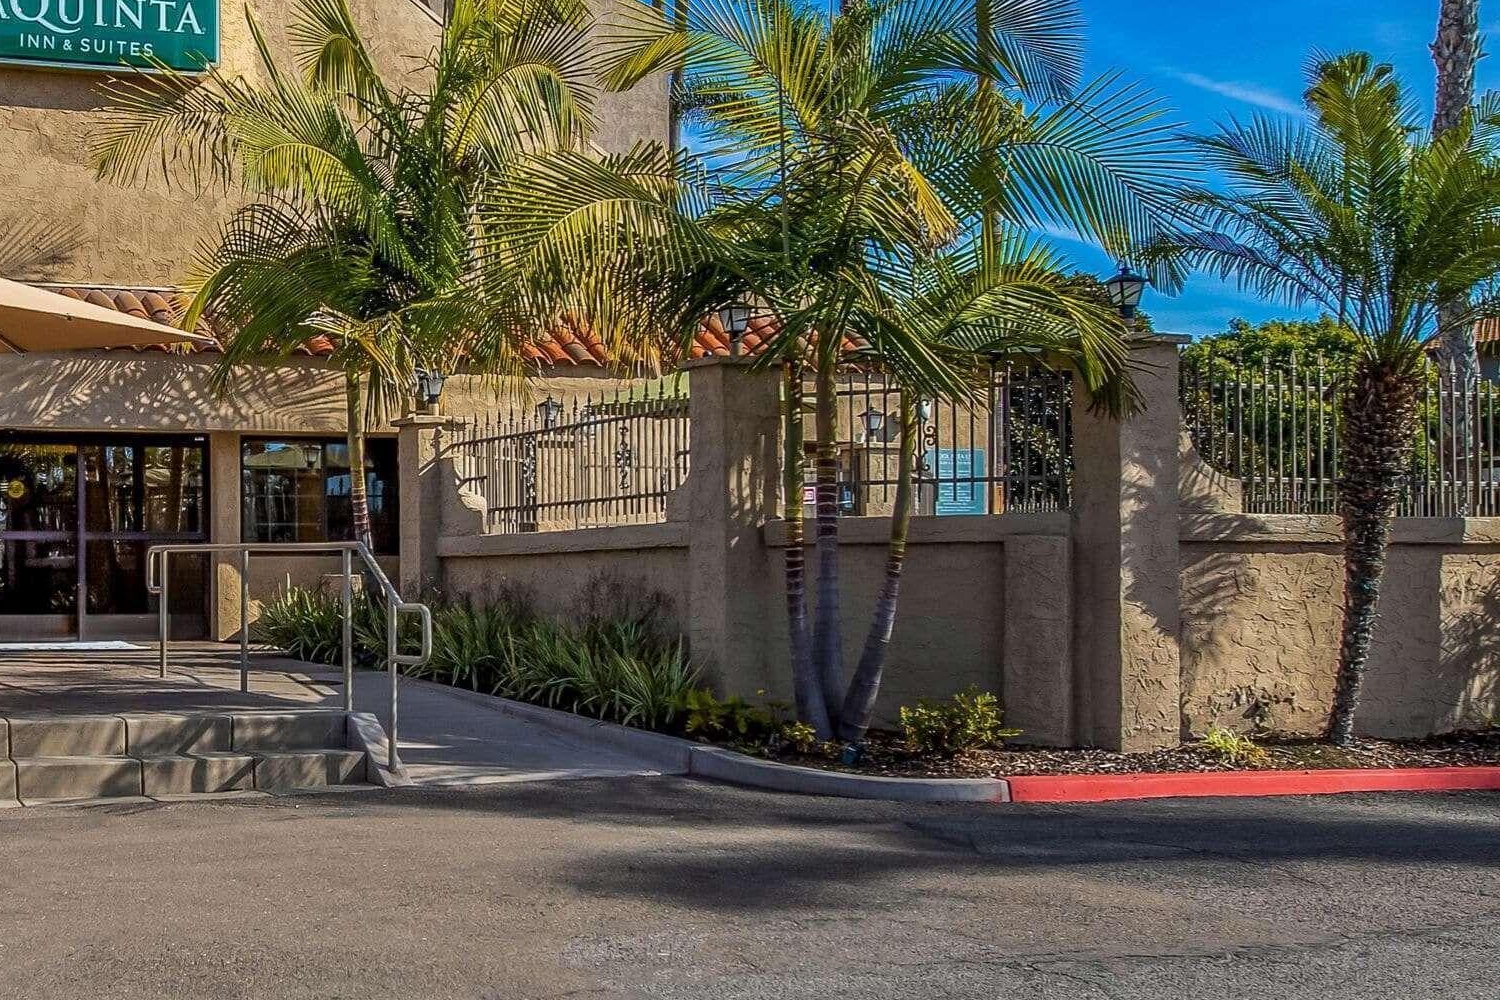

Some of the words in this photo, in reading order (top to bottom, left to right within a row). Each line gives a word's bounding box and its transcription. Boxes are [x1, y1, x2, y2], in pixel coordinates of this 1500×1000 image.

[19, 33, 55, 50] INN
[62, 39, 73, 51] &
[80, 38, 154, 57] SUITES
